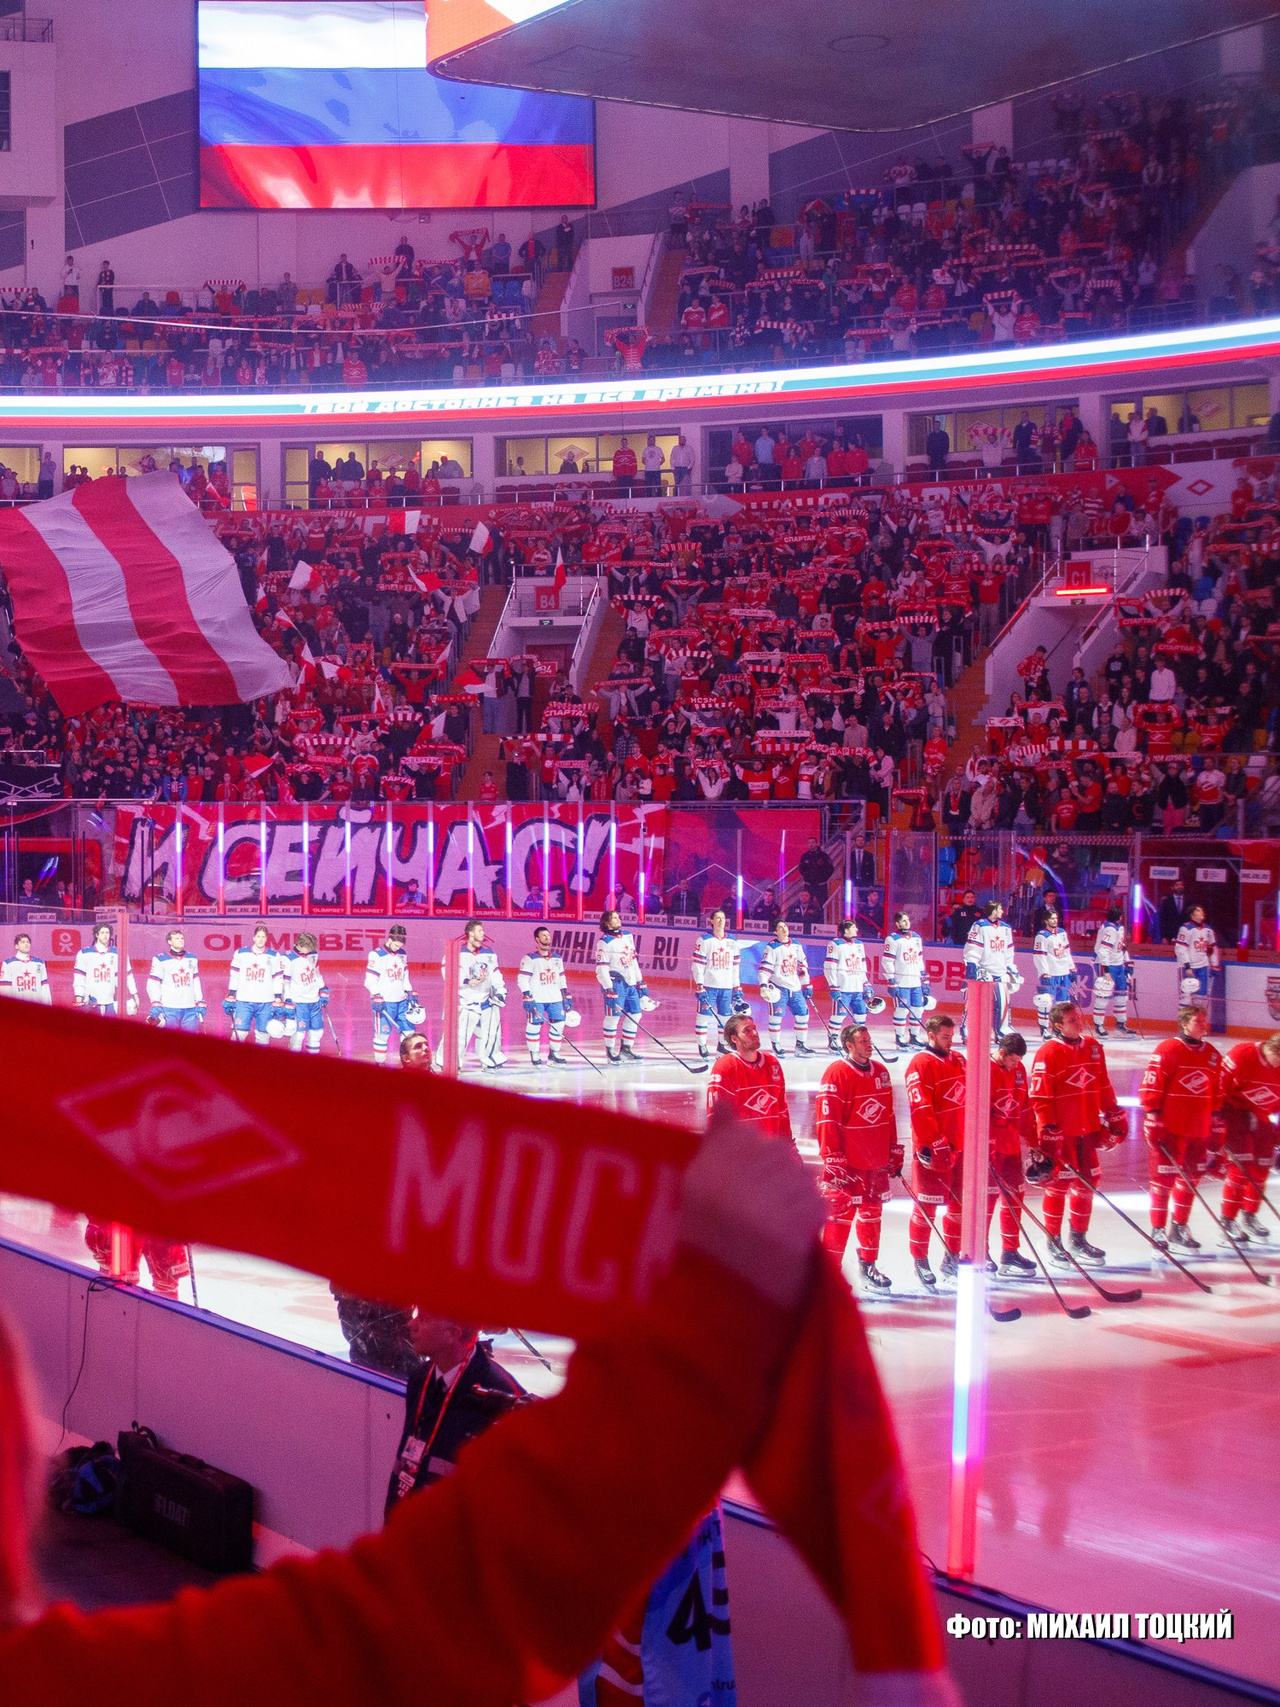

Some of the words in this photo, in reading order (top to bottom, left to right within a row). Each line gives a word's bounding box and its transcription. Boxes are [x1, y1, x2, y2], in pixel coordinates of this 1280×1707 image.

[613, 275, 632, 288] B24
[304, 399, 370, 414] Твоё
[374, 395, 535, 414] достоянье
[540, 394, 577, 406] на
[587, 388, 637, 403] все
[643, 381, 784, 402] времена!
[784, 535, 816, 543] СПАРТАК
[1072, 571, 1086, 586] C1
[540, 595, 555, 609] B4
[1123, 617, 1157, 625] СПАРТАК
[1158, 644, 1195, 652] СПАРТАК
[829, 747, 869, 756] ПАРТАК
[121, 817, 188, 903] И
[197, 803, 619, 908] СЕЙЧАС!
[28, 913, 56, 921] MHL.KHL.RU
[645, 916, 667, 924] MHL.KHL.RU
[675, 918, 698, 926] MHL.KHL.RU
[744, 922, 768, 930] MHL.KHL.RU
[204, 932, 387, 952] OLMBET
[909, 1088, 922, 1103] 13
[822, 1099, 830, 1116] 6
[385, 1100, 684, 1308] МОСК
[920, 1195, 943, 1203] СПАРТАК
